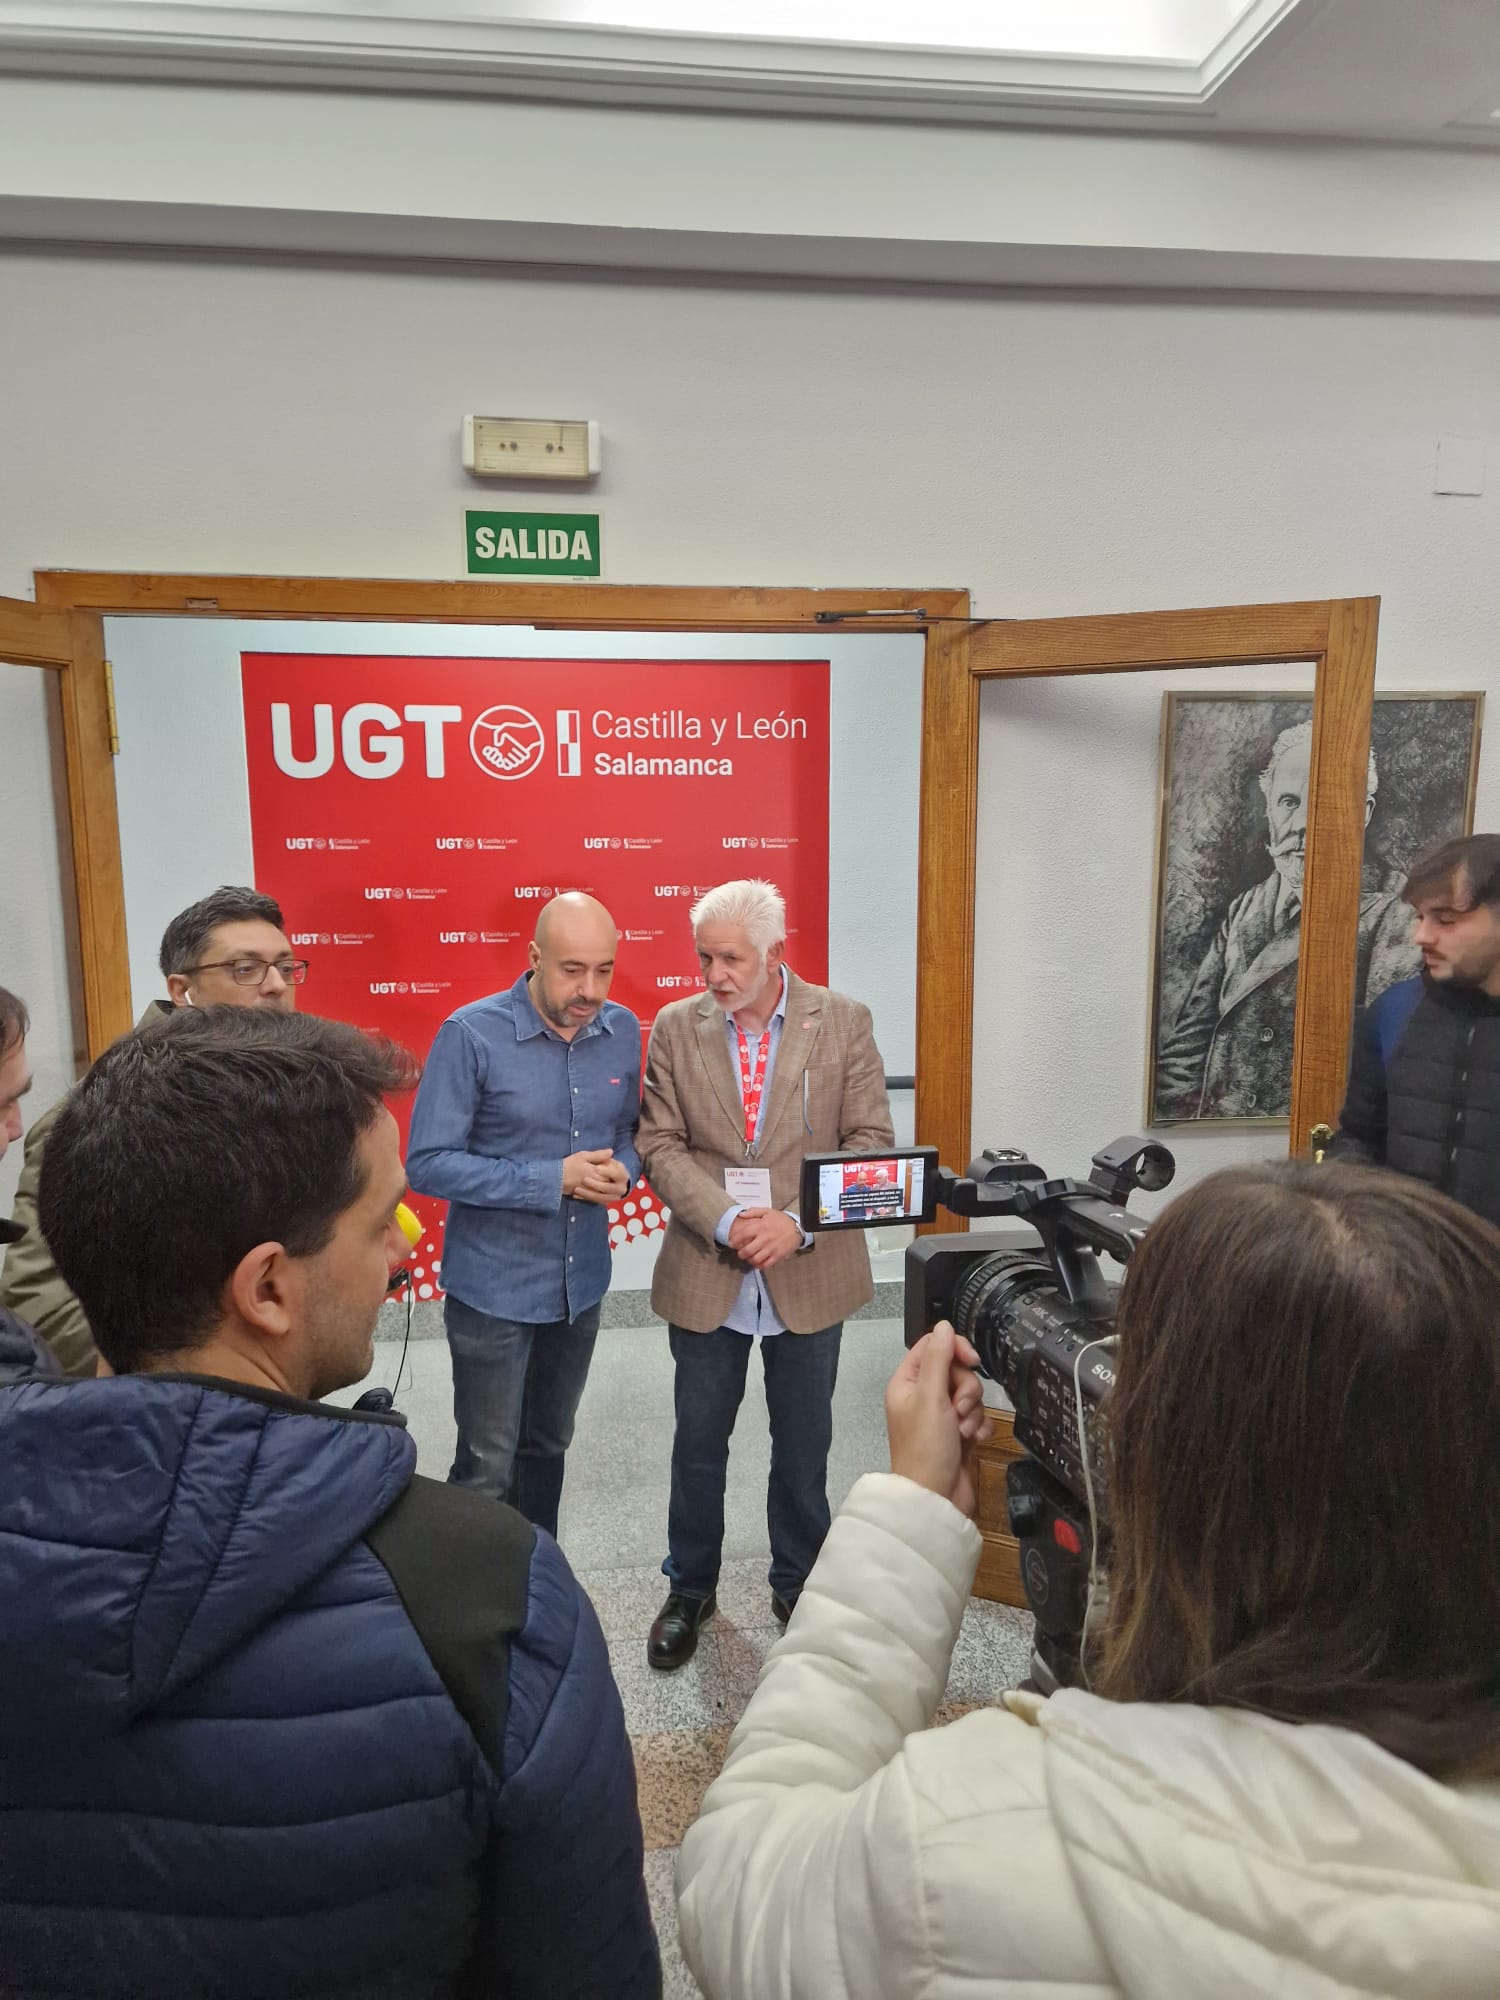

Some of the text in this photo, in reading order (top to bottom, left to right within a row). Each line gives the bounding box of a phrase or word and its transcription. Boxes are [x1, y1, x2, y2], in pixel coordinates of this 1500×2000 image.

[475, 526, 592, 560] SALIDA
[591, 709, 807, 746] Castilla y León
[270, 702, 462, 780] UGT
[594, 751, 733, 776] Salamanca
[286, 838, 314, 850] UGT
[436, 838, 463, 849] UGT
[584, 837, 610, 849] UGT
[722, 837, 748, 848] UGT
[364, 887, 392, 899] UGT
[514, 886, 540, 898] UGT
[654, 885, 680, 896] UGT
[291, 933, 318, 945] UGT
[440, 931, 466, 943] UGT
[656, 976, 681, 987] UGT
[370, 982, 396, 994] UGT
[844, 1164, 860, 1173] UGT
[1091, 1363, 1116, 1387] SON
